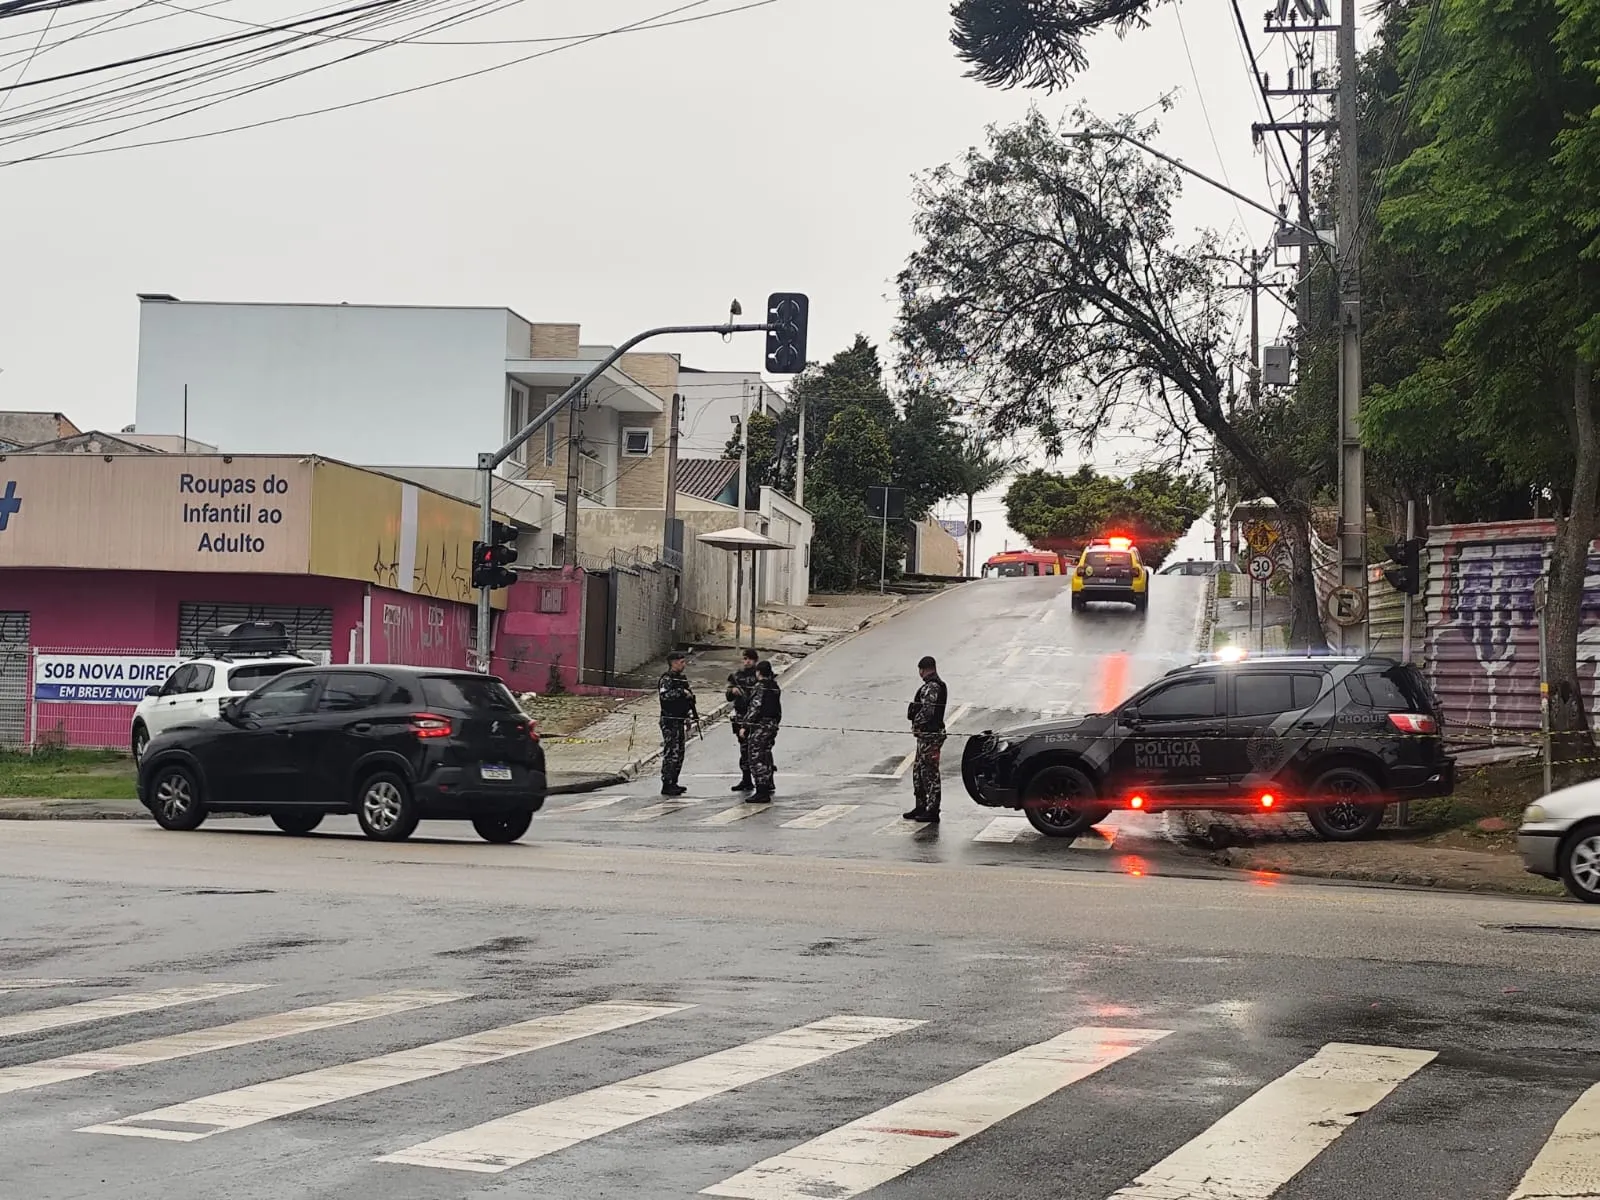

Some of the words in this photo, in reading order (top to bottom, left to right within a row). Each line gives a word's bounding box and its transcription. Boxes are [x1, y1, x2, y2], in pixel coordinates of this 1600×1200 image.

[180, 474, 256, 498] Roupas
[263, 474, 288, 494] do
[183, 503, 251, 523] Infantil
[257, 508, 282, 524] ao
[197, 532, 264, 553] Adulto
[1252, 560, 1270, 572] 30
[44, 663, 75, 679] SOB
[79, 663, 124, 680] NOVA
[59, 686, 76, 698] EM
[78, 686, 112, 699] BREVE
[1337, 714, 1385, 724] CHOQUE
[1135, 754, 1201, 767] MILITAR
